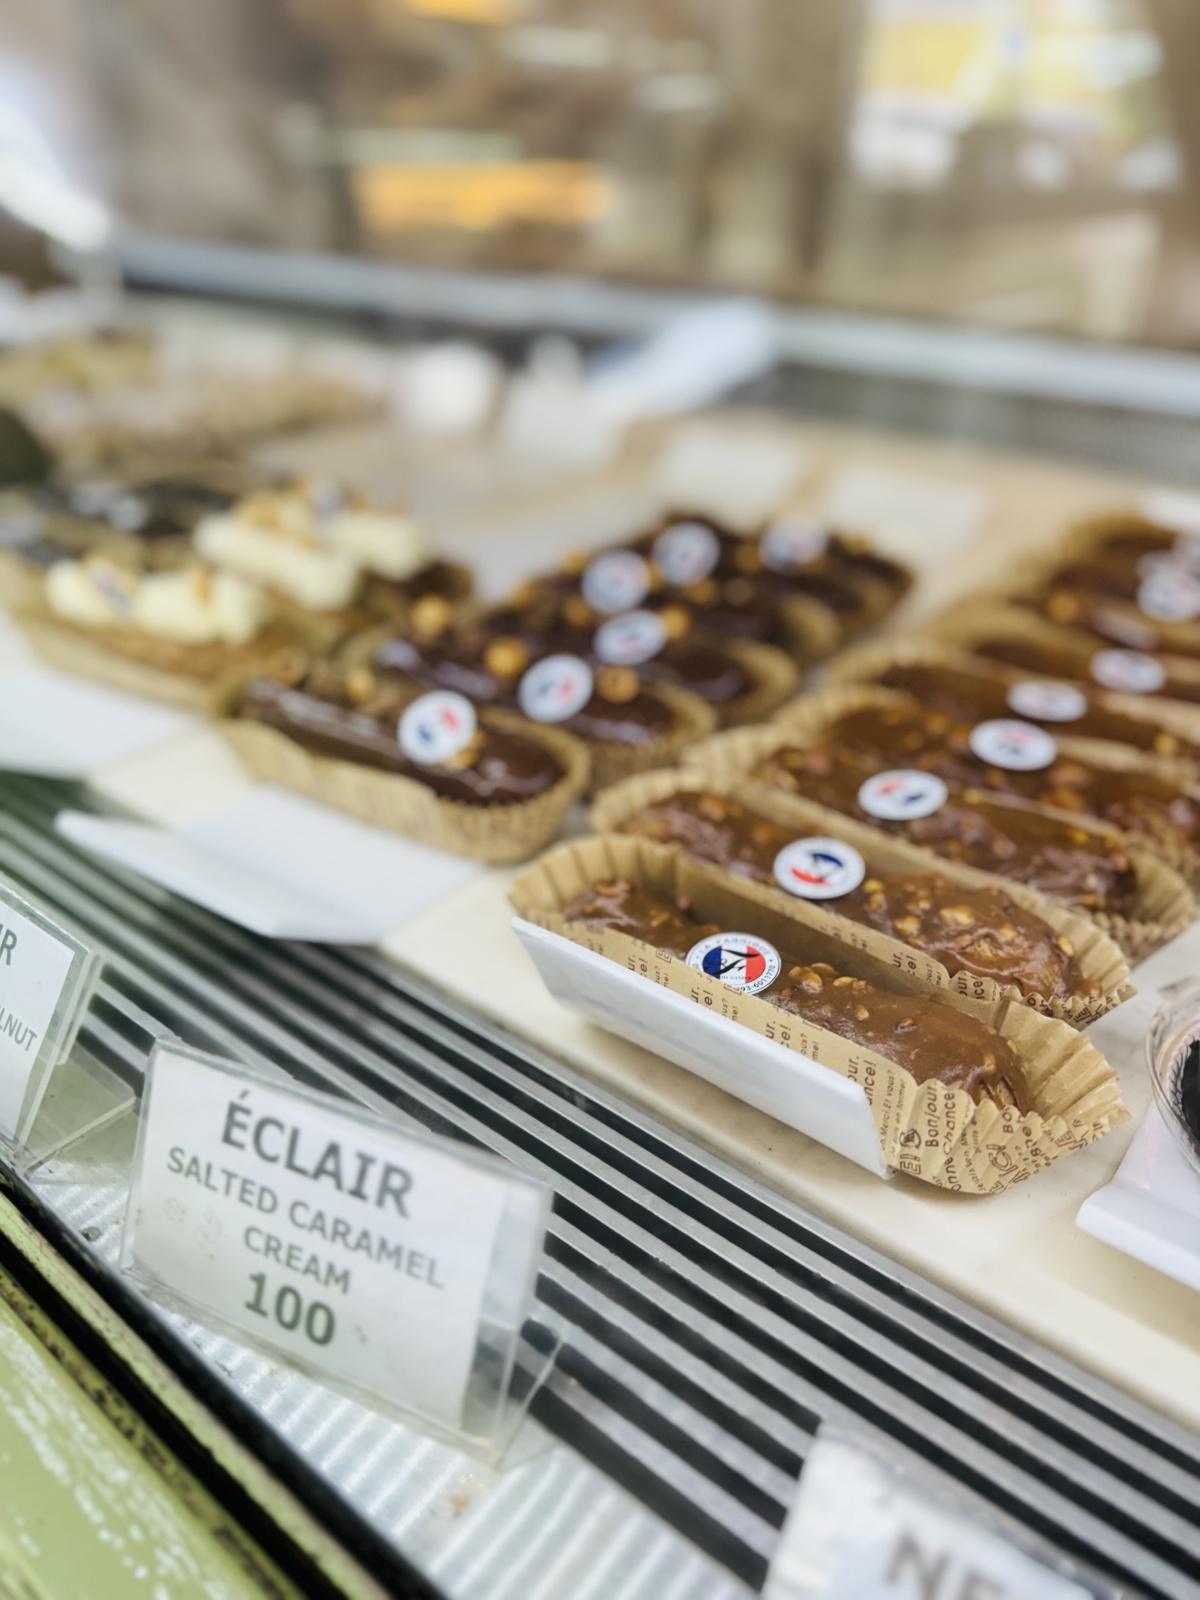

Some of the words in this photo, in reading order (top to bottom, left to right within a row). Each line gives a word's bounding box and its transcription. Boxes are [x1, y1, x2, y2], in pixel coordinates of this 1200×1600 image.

[221, 1089, 414, 1219] ÉCLAIR
[167, 1146, 278, 1214] SALTED
[288, 1200, 443, 1289] CARAMEL
[243, 1226, 350, 1294] CREAM
[245, 1272, 335, 1346] 100
